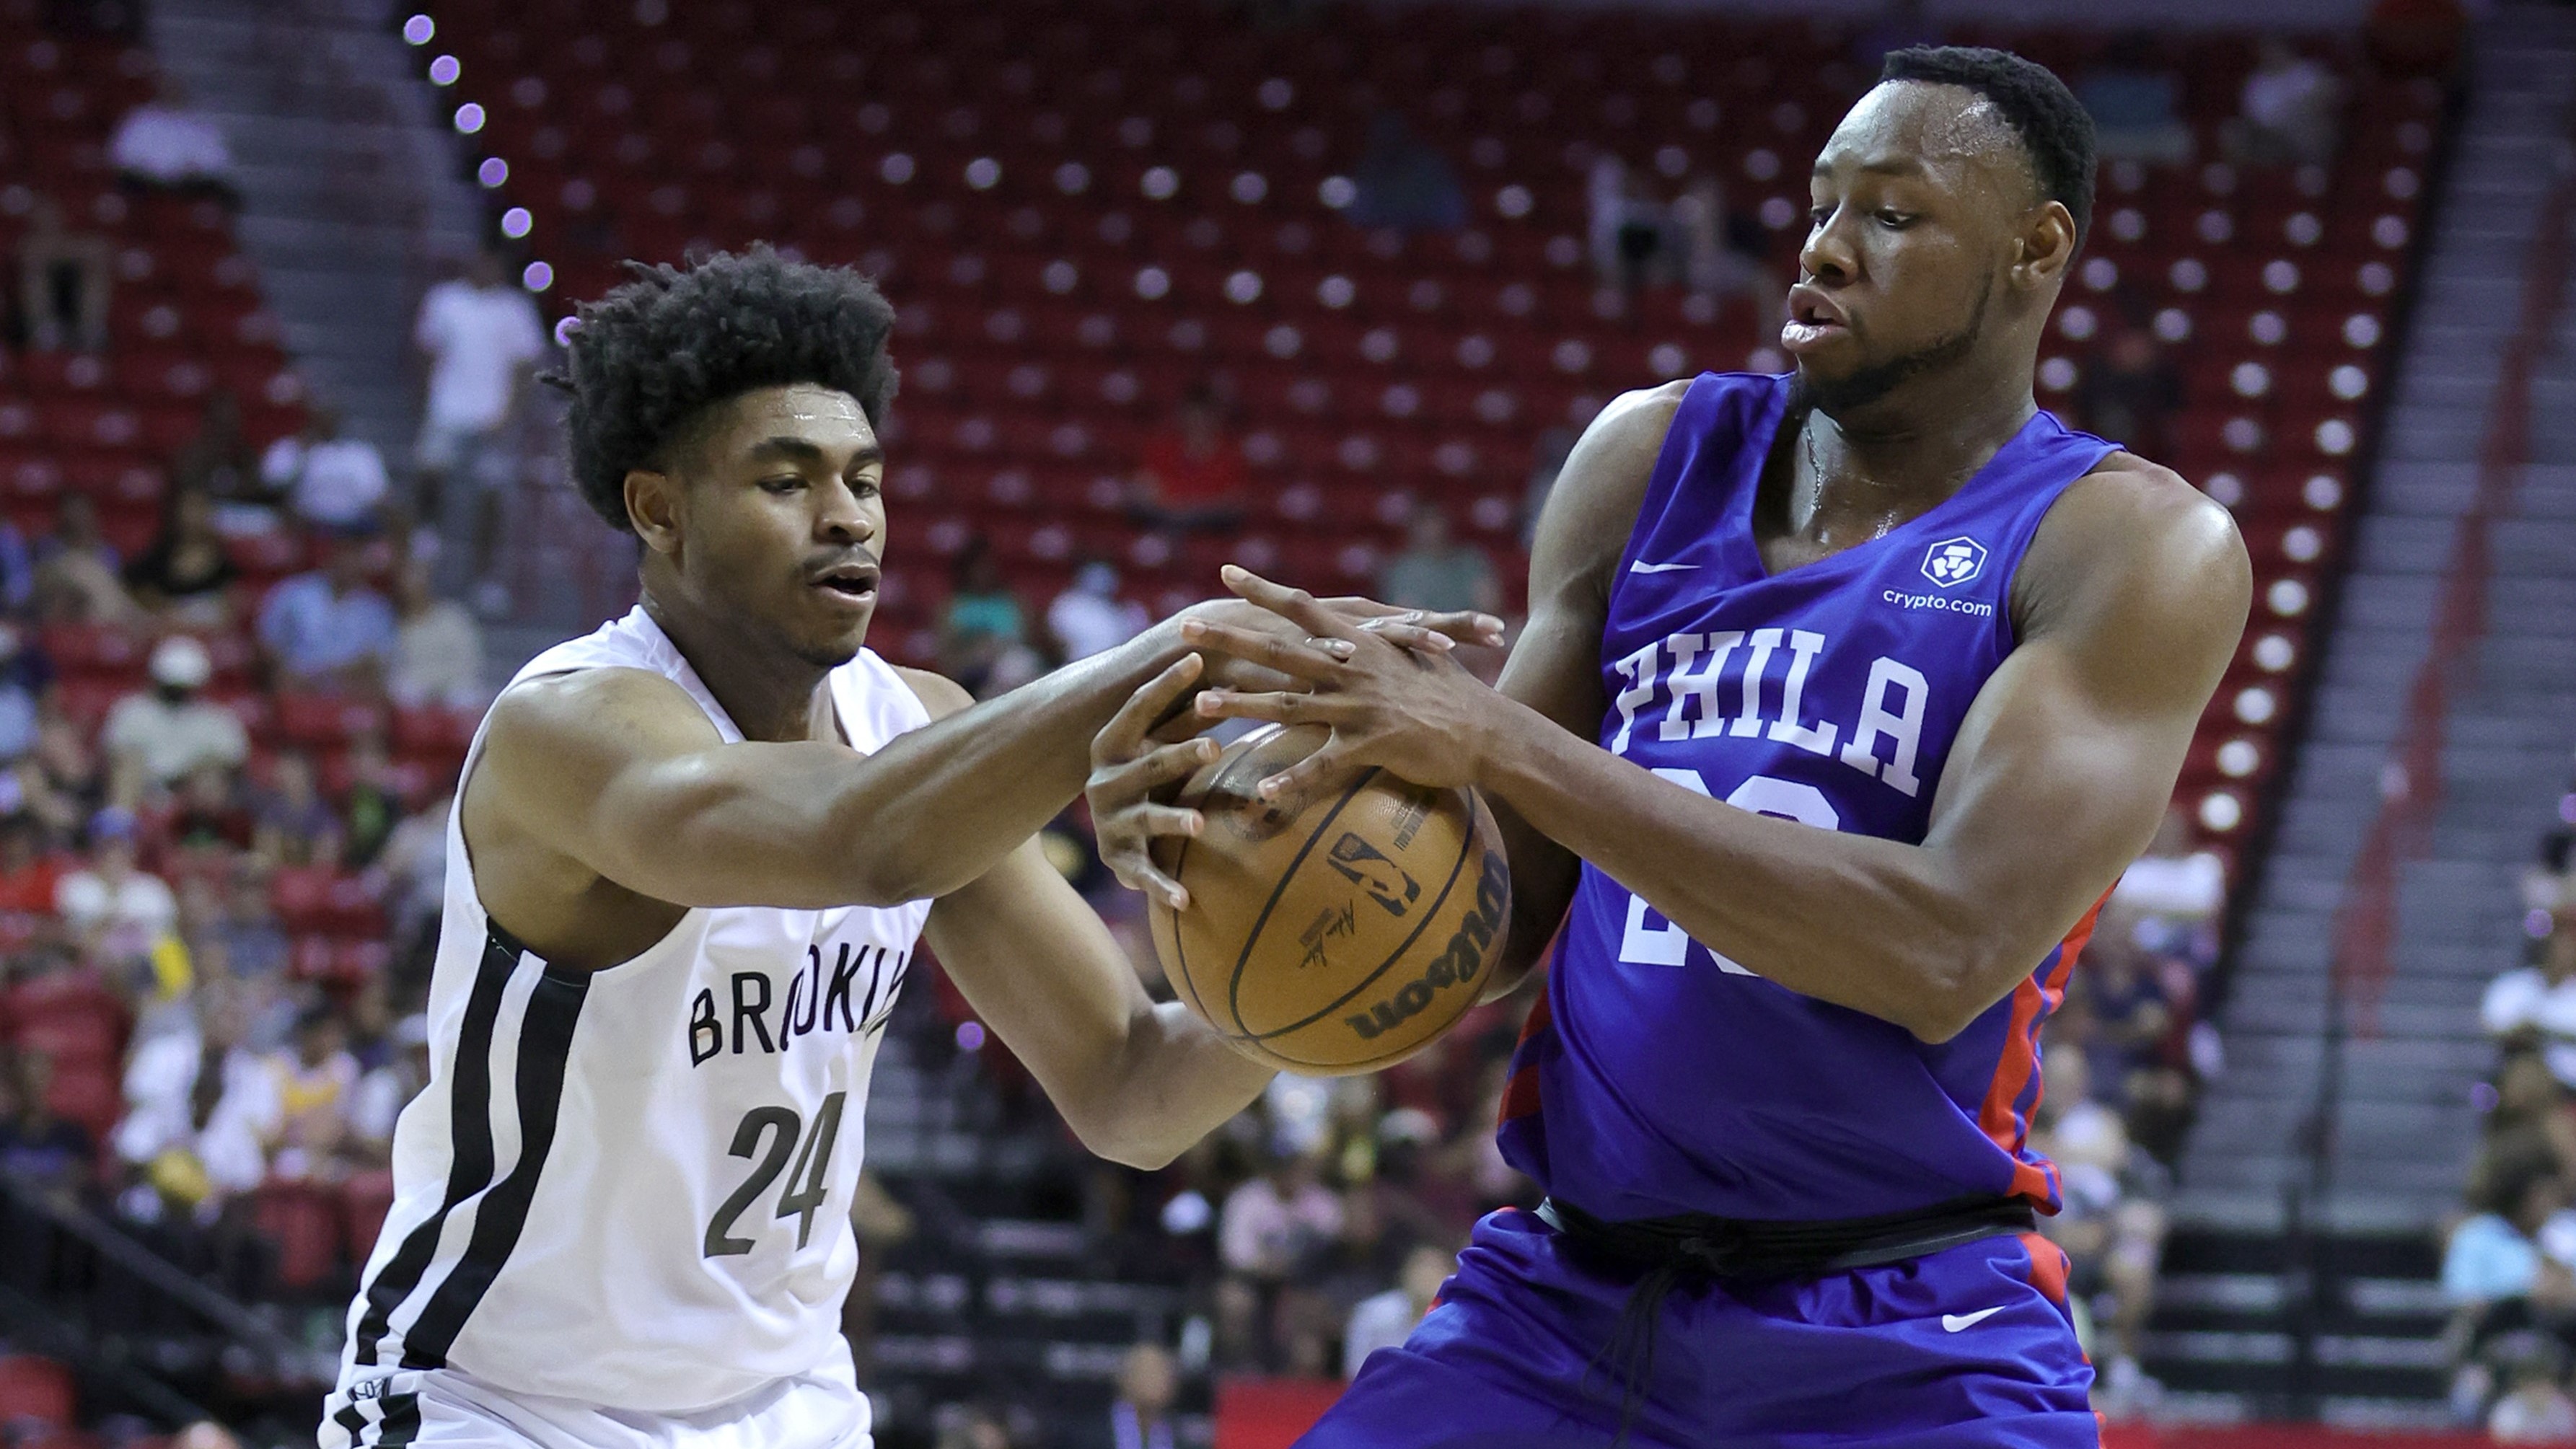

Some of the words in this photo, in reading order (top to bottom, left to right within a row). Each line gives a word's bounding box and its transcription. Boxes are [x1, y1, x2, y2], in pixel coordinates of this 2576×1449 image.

[1883, 590, 1992, 617] crypto.com
[1612, 628, 1929, 797] PHILA
[1346, 850, 1509, 1039] Wilson
[704, 1091, 846, 1259] 24
